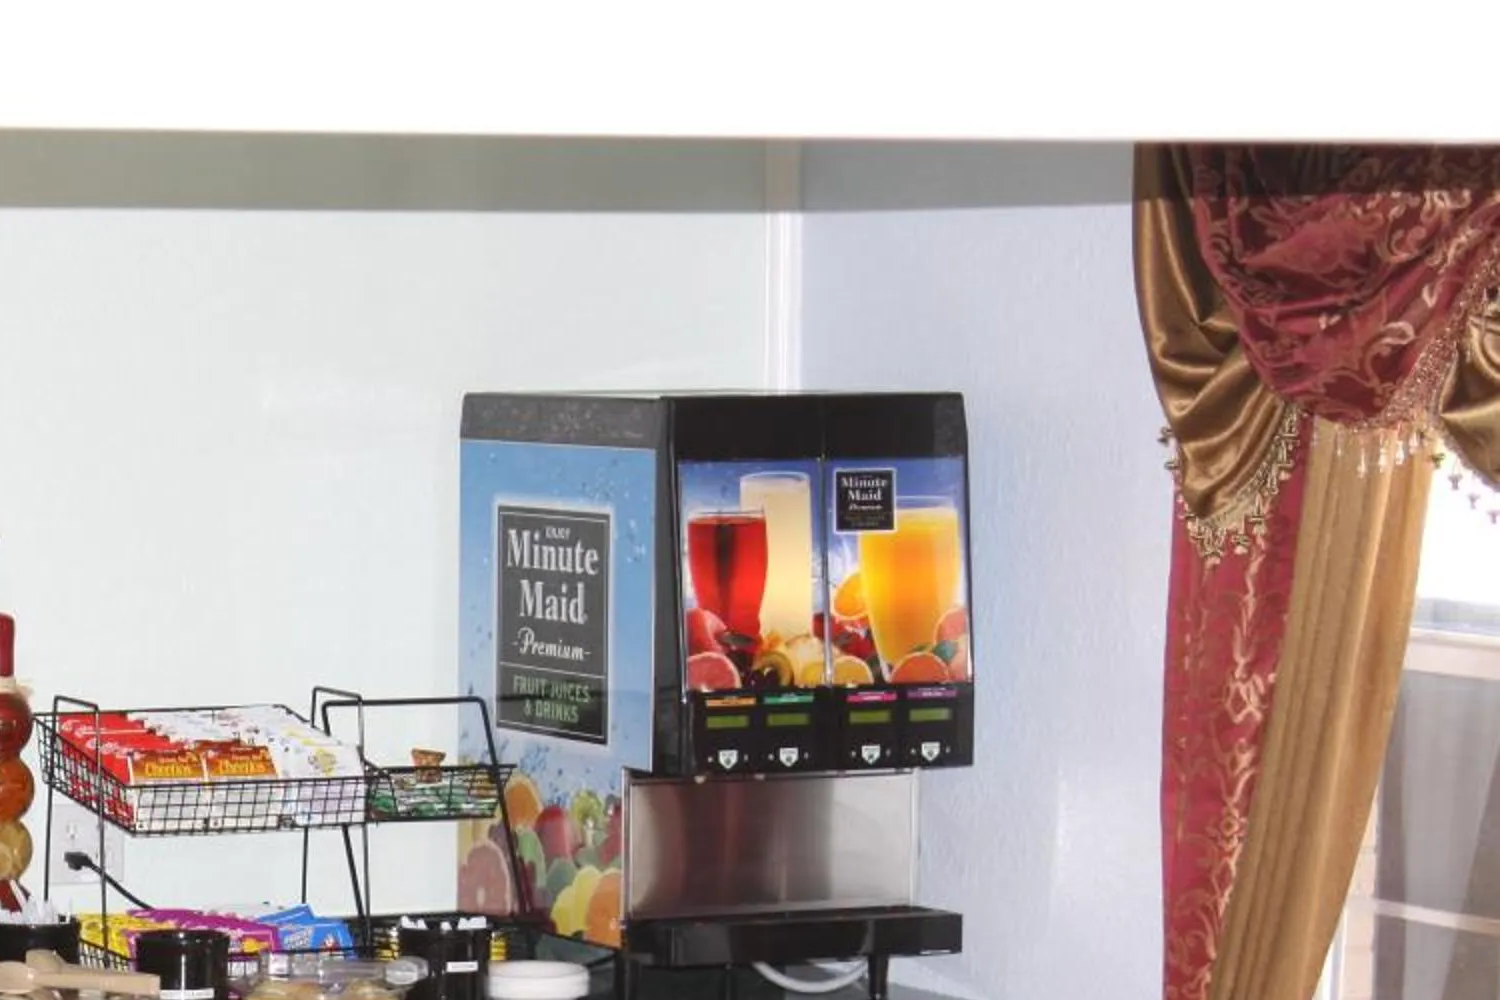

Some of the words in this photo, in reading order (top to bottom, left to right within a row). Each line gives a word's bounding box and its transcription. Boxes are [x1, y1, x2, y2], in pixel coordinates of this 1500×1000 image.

[841, 476, 888, 488] Minute
[848, 488, 882, 501] Maid
[506, 528, 599, 576] Minute
[519, 579, 585, 625] Maid
[517, 626, 584, 661] Premium
[513, 674, 548, 696] FRUIT
[551, 681, 591, 702] JUICES
[535, 701, 579, 723] DRINKS
